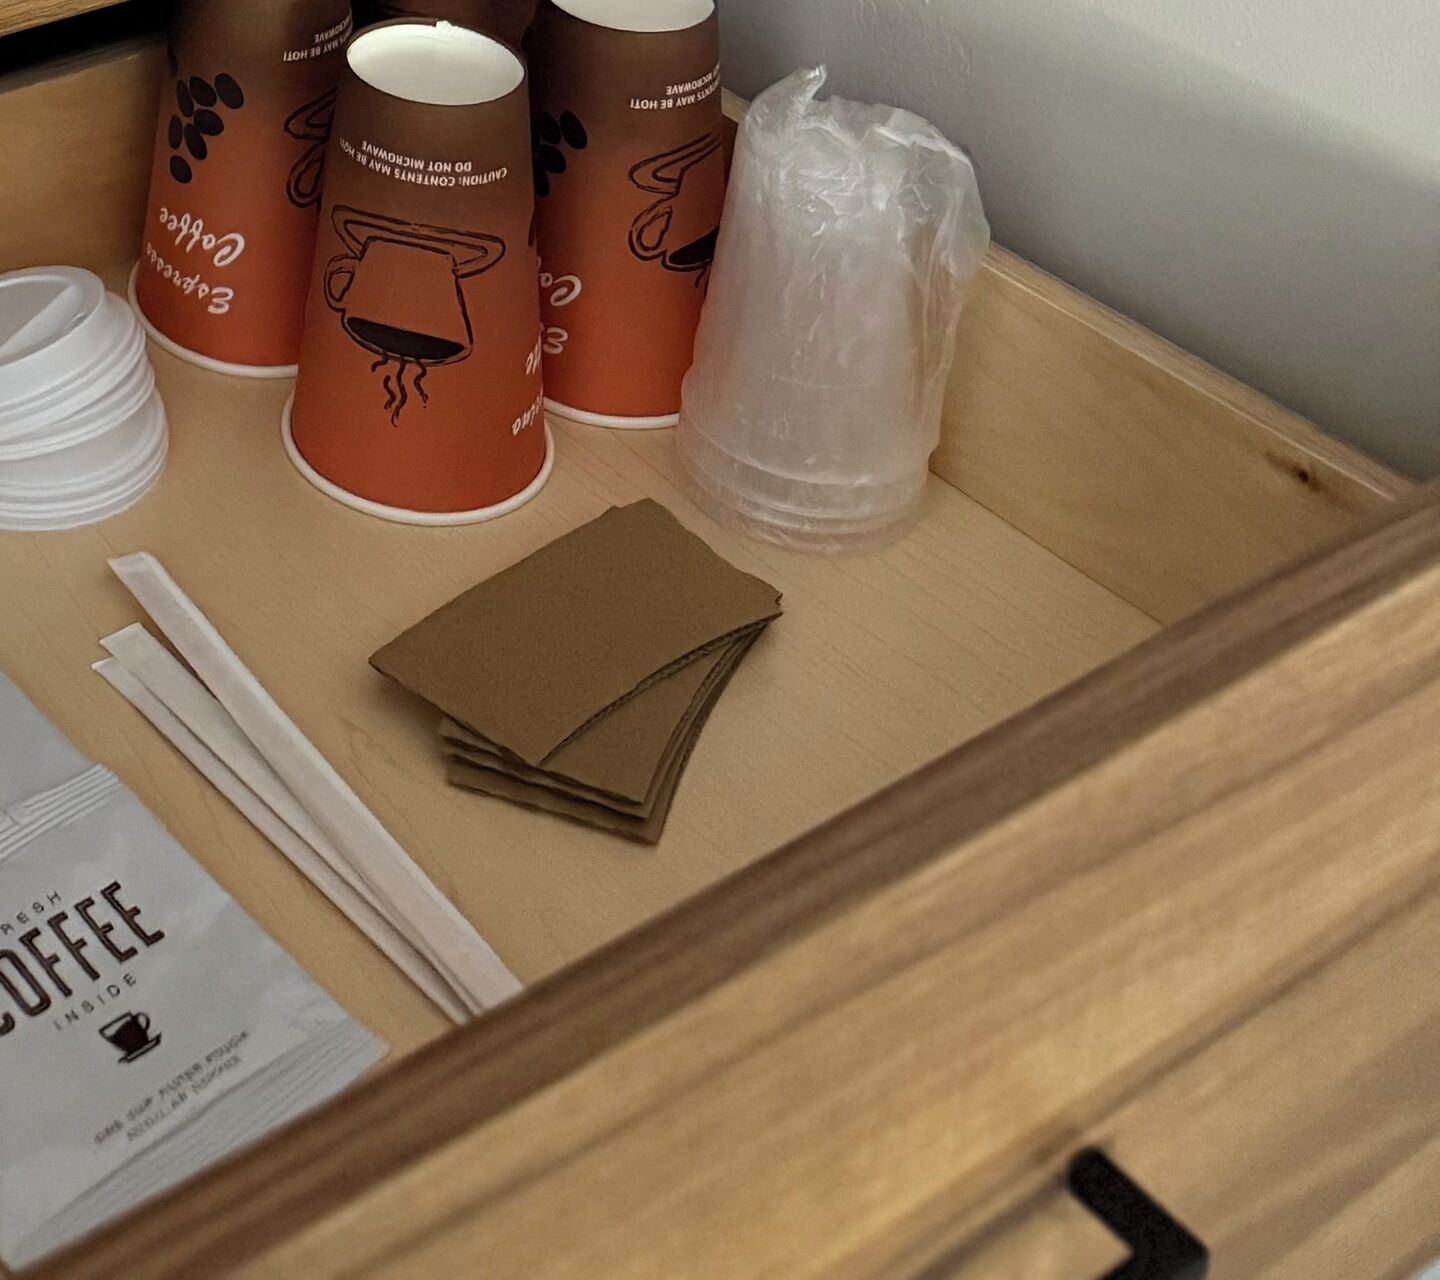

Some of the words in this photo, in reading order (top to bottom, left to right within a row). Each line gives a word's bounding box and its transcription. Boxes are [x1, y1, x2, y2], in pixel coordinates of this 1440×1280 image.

[660, 98, 673, 110] BE
[675, 93, 696, 107] MAY
[355, 151, 368, 166] BE
[361, 140, 425, 171] MICROWAVE
[368, 158, 391, 176] MAY
[427, 161, 452, 173] NOT
[454, 160, 472, 173] DO
[394, 168, 456, 187] CONTENTS
[458, 167, 508, 186] CAUTION:
[159, 205, 245, 268] Coffee
[146, 241, 234, 314] Espresso
[52, 972, 137, 1031] INSIDE
